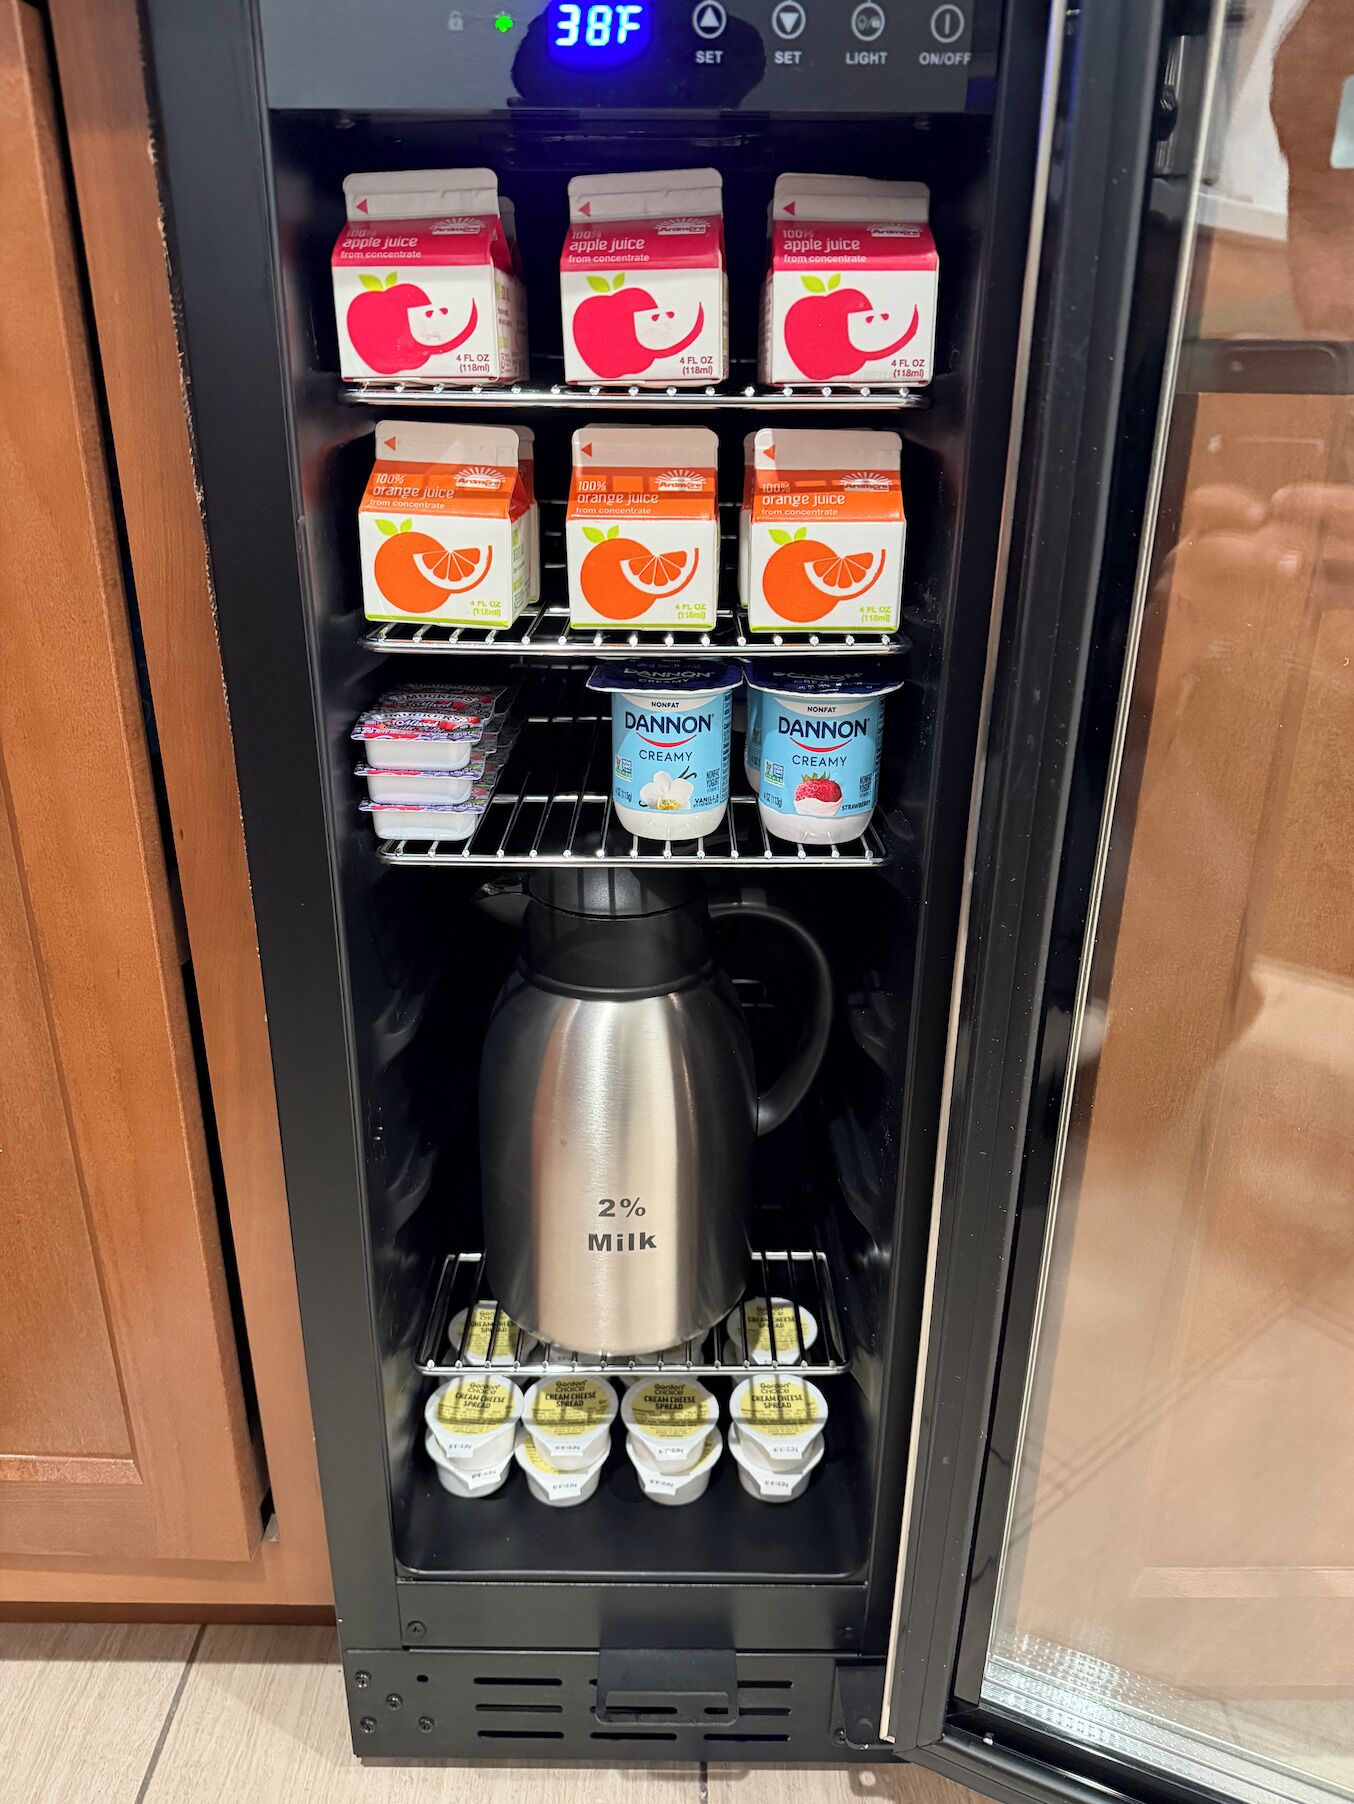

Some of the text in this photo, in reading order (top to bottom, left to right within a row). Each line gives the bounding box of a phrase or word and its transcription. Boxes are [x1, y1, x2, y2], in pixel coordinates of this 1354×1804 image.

[695, 50, 723, 64] SET
[774, 51, 802, 64] SET
[845, 51, 888, 65] LIGHT
[919, 51, 972, 65] ON/OFF
[342, 237, 418, 250] apple juice
[569, 238, 645, 253] apple juice
[784, 239, 860, 253] apple juice
[364, 251, 422, 259] concentrate
[568, 254, 650, 263] from concentrate
[784, 255, 867, 263] from concentrate
[700, 356, 713, 364] OZ
[912, 359, 925, 367] OZ
[459, 364, 490, 373] (118ml)
[682, 366, 713, 375] (118ml)
[893, 369, 924, 378] (118ml)
[375, 473, 405, 485] 100%
[577, 480, 607, 491] 100%
[762, 481, 791, 493] 100%
[373, 486, 455, 500] orange juice
[577, 492, 659, 505] orange juice
[370, 499, 445, 510] from concentrate
[762, 494, 845, 507] orange juice
[761, 508, 838, 516] from concentrate
[651, 701, 680, 709] NONFAT
[625, 711, 714, 734] DANNON
[778, 716, 869, 739] DANNON
[638, 750, 693, 762] CREAMY
[791, 755, 848, 767] CREAMY
[694, 794, 719, 804] VANILLA
[598, 1197, 646, 1218] 2%
[588, 1232, 657, 1251] Milk
[455, 1392, 505, 1403] CREAM CHEESE
[571, 1391, 597, 1399] CHEESE
[463, 1400, 491, 1408] SPREAD
